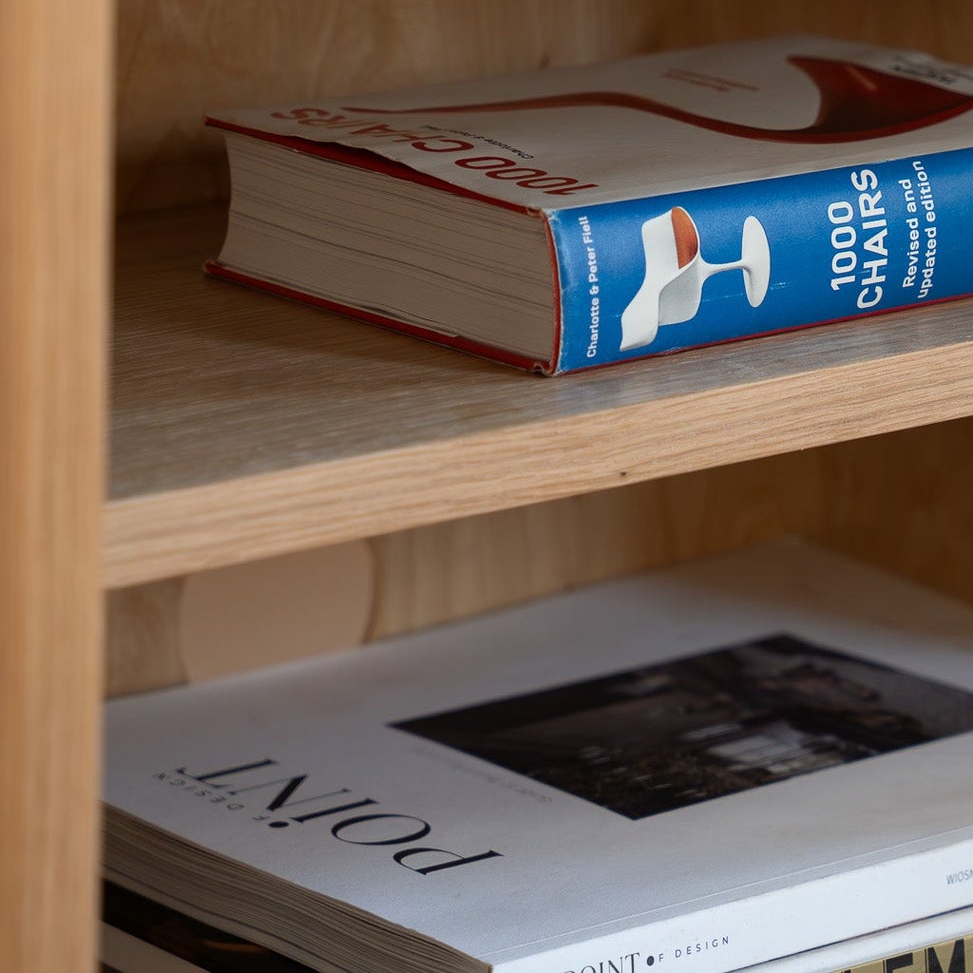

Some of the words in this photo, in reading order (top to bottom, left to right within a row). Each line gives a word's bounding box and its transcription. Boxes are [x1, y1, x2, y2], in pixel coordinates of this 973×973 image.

[269, 107, 475, 153] CHAIRS
[455, 156, 600, 195] 1000
[898, 179, 917, 213] and
[912, 160, 936, 222] edition
[578, 216, 593, 244] Fiell
[828, 201, 857, 290] 1000
[851, 169, 888, 309] CHAIRS
[902, 218, 920, 287] Revised
[587, 246, 599, 283] Peter
[917, 227, 937, 298] updated
[589, 285, 599, 295] &
[587, 298, 600, 358] Charlotte
[173, 757, 504, 876] POINT
[674, 936, 730, 958] DESIGN
